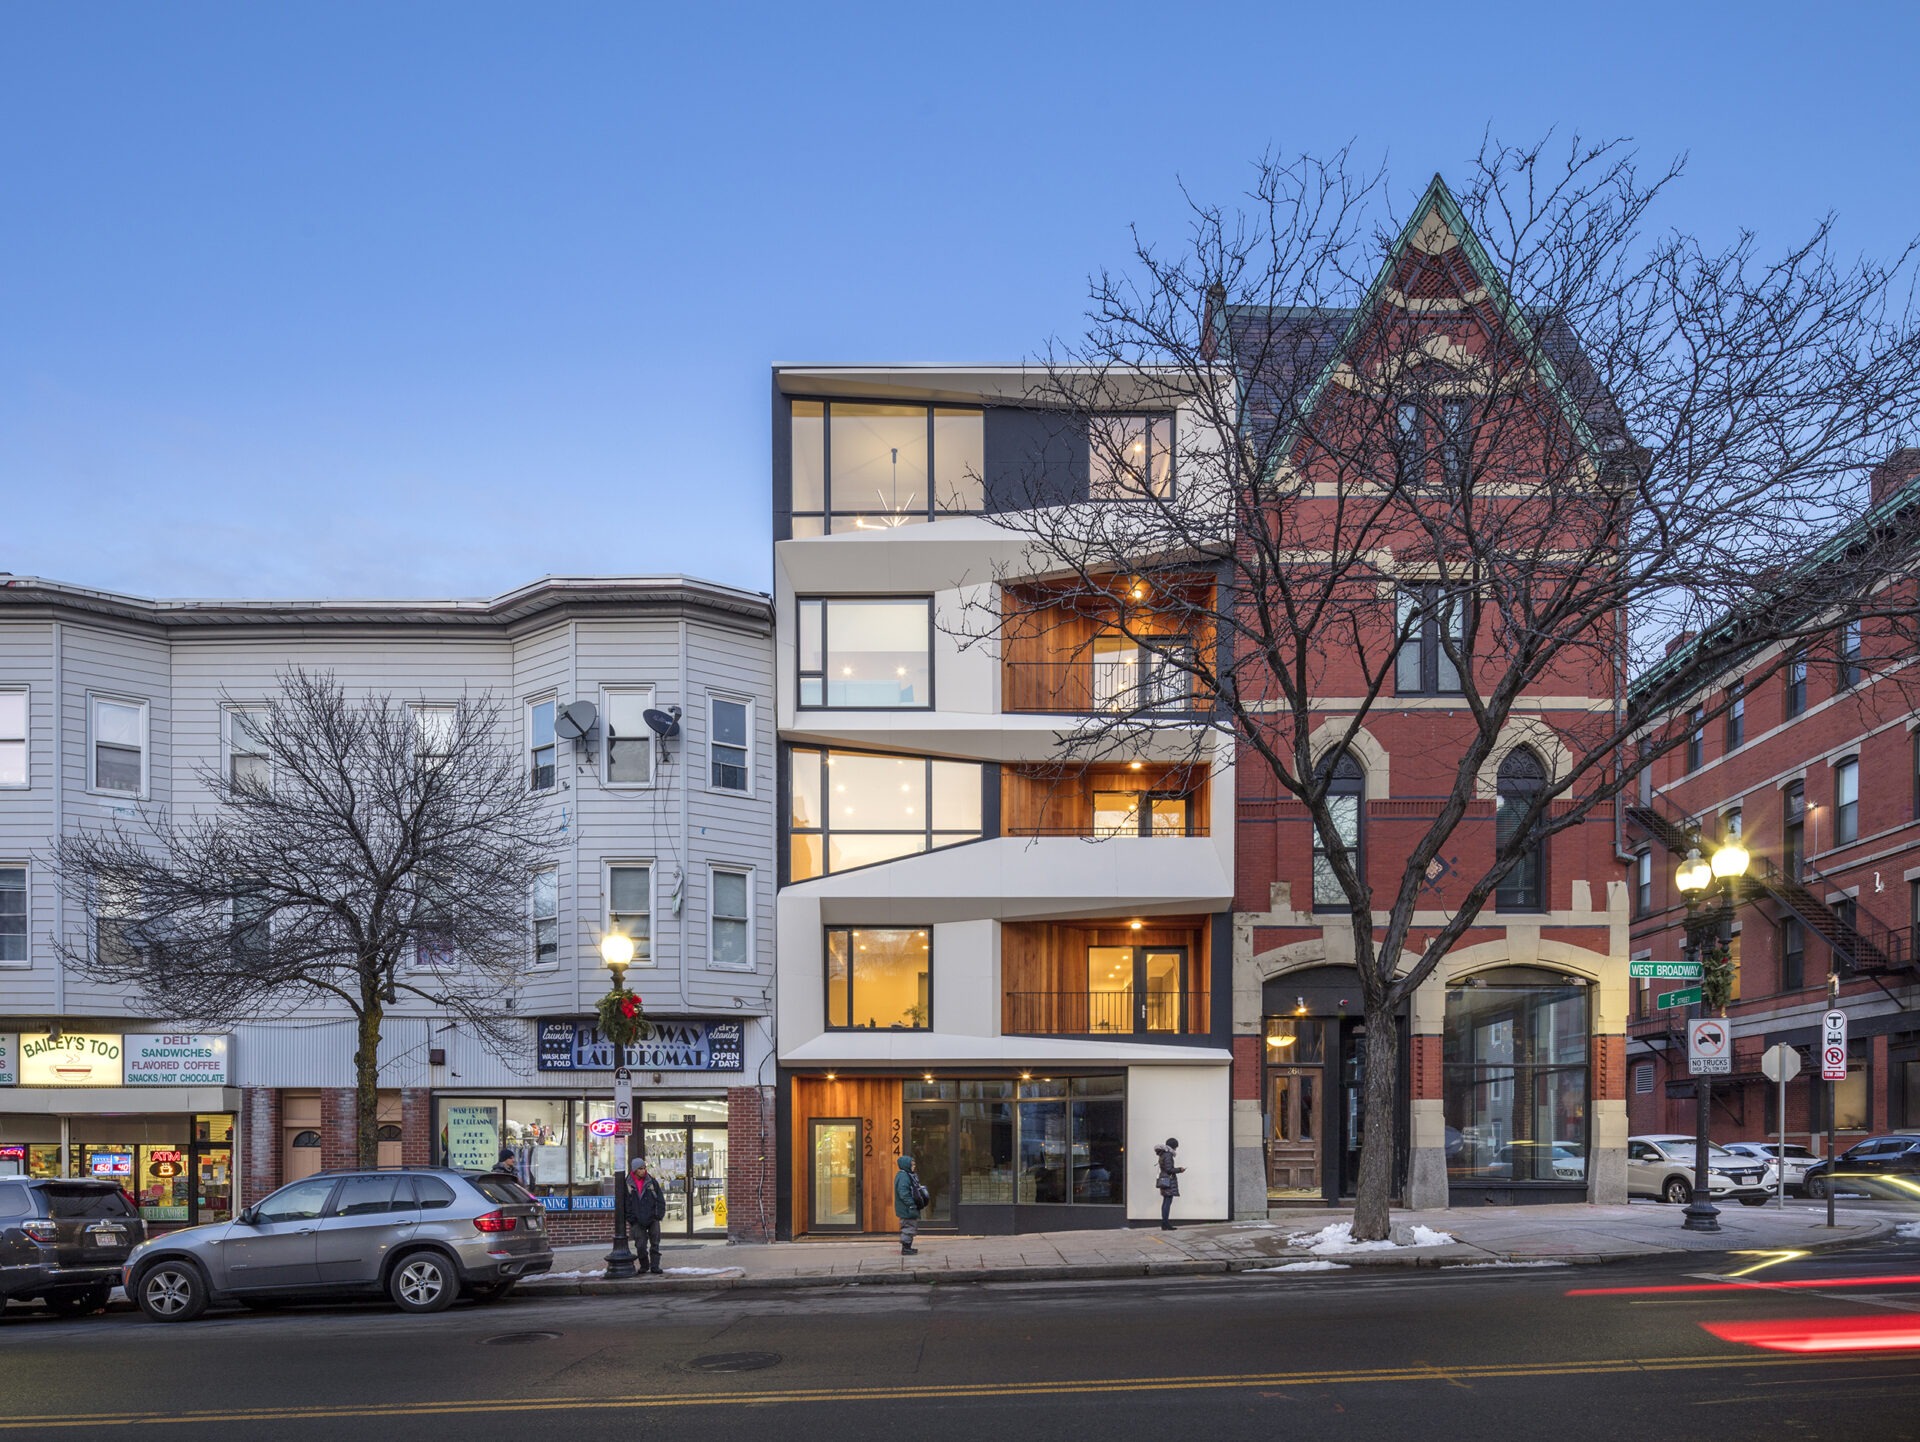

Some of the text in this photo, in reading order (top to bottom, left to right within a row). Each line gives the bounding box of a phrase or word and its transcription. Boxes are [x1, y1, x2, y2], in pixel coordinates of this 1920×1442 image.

[1631, 964, 1700, 976] WEST BROADWAY
[1670, 994, 1691, 1006] E STREET
[548, 1022, 572, 1031] coin
[718, 1024, 739, 1034] dry
[163, 1036, 190, 1045] DELI
[542, 1028, 574, 1043] laundry
[577, 1024, 704, 1048] BRDWAY
[708, 1028, 740, 1042] cleaning
[23, 1036, 119, 1060] BAILEY'S TOO
[141, 1048, 212, 1058] SANDWICHES
[577, 1050, 705, 1067] LAUDROMAT
[712, 1052, 740, 1060] OPEN
[132, 1061, 220, 1070] FLAVORED COFFEE
[128, 1073, 225, 1083] SNACKS/HOT CHOCOLATE
[864, 1118, 873, 1157] 362
[892, 1118, 901, 1157] 364
[151, 1151, 181, 1161] ATM
[539, 1198, 615, 1209] ANING DELIVERY SERV
